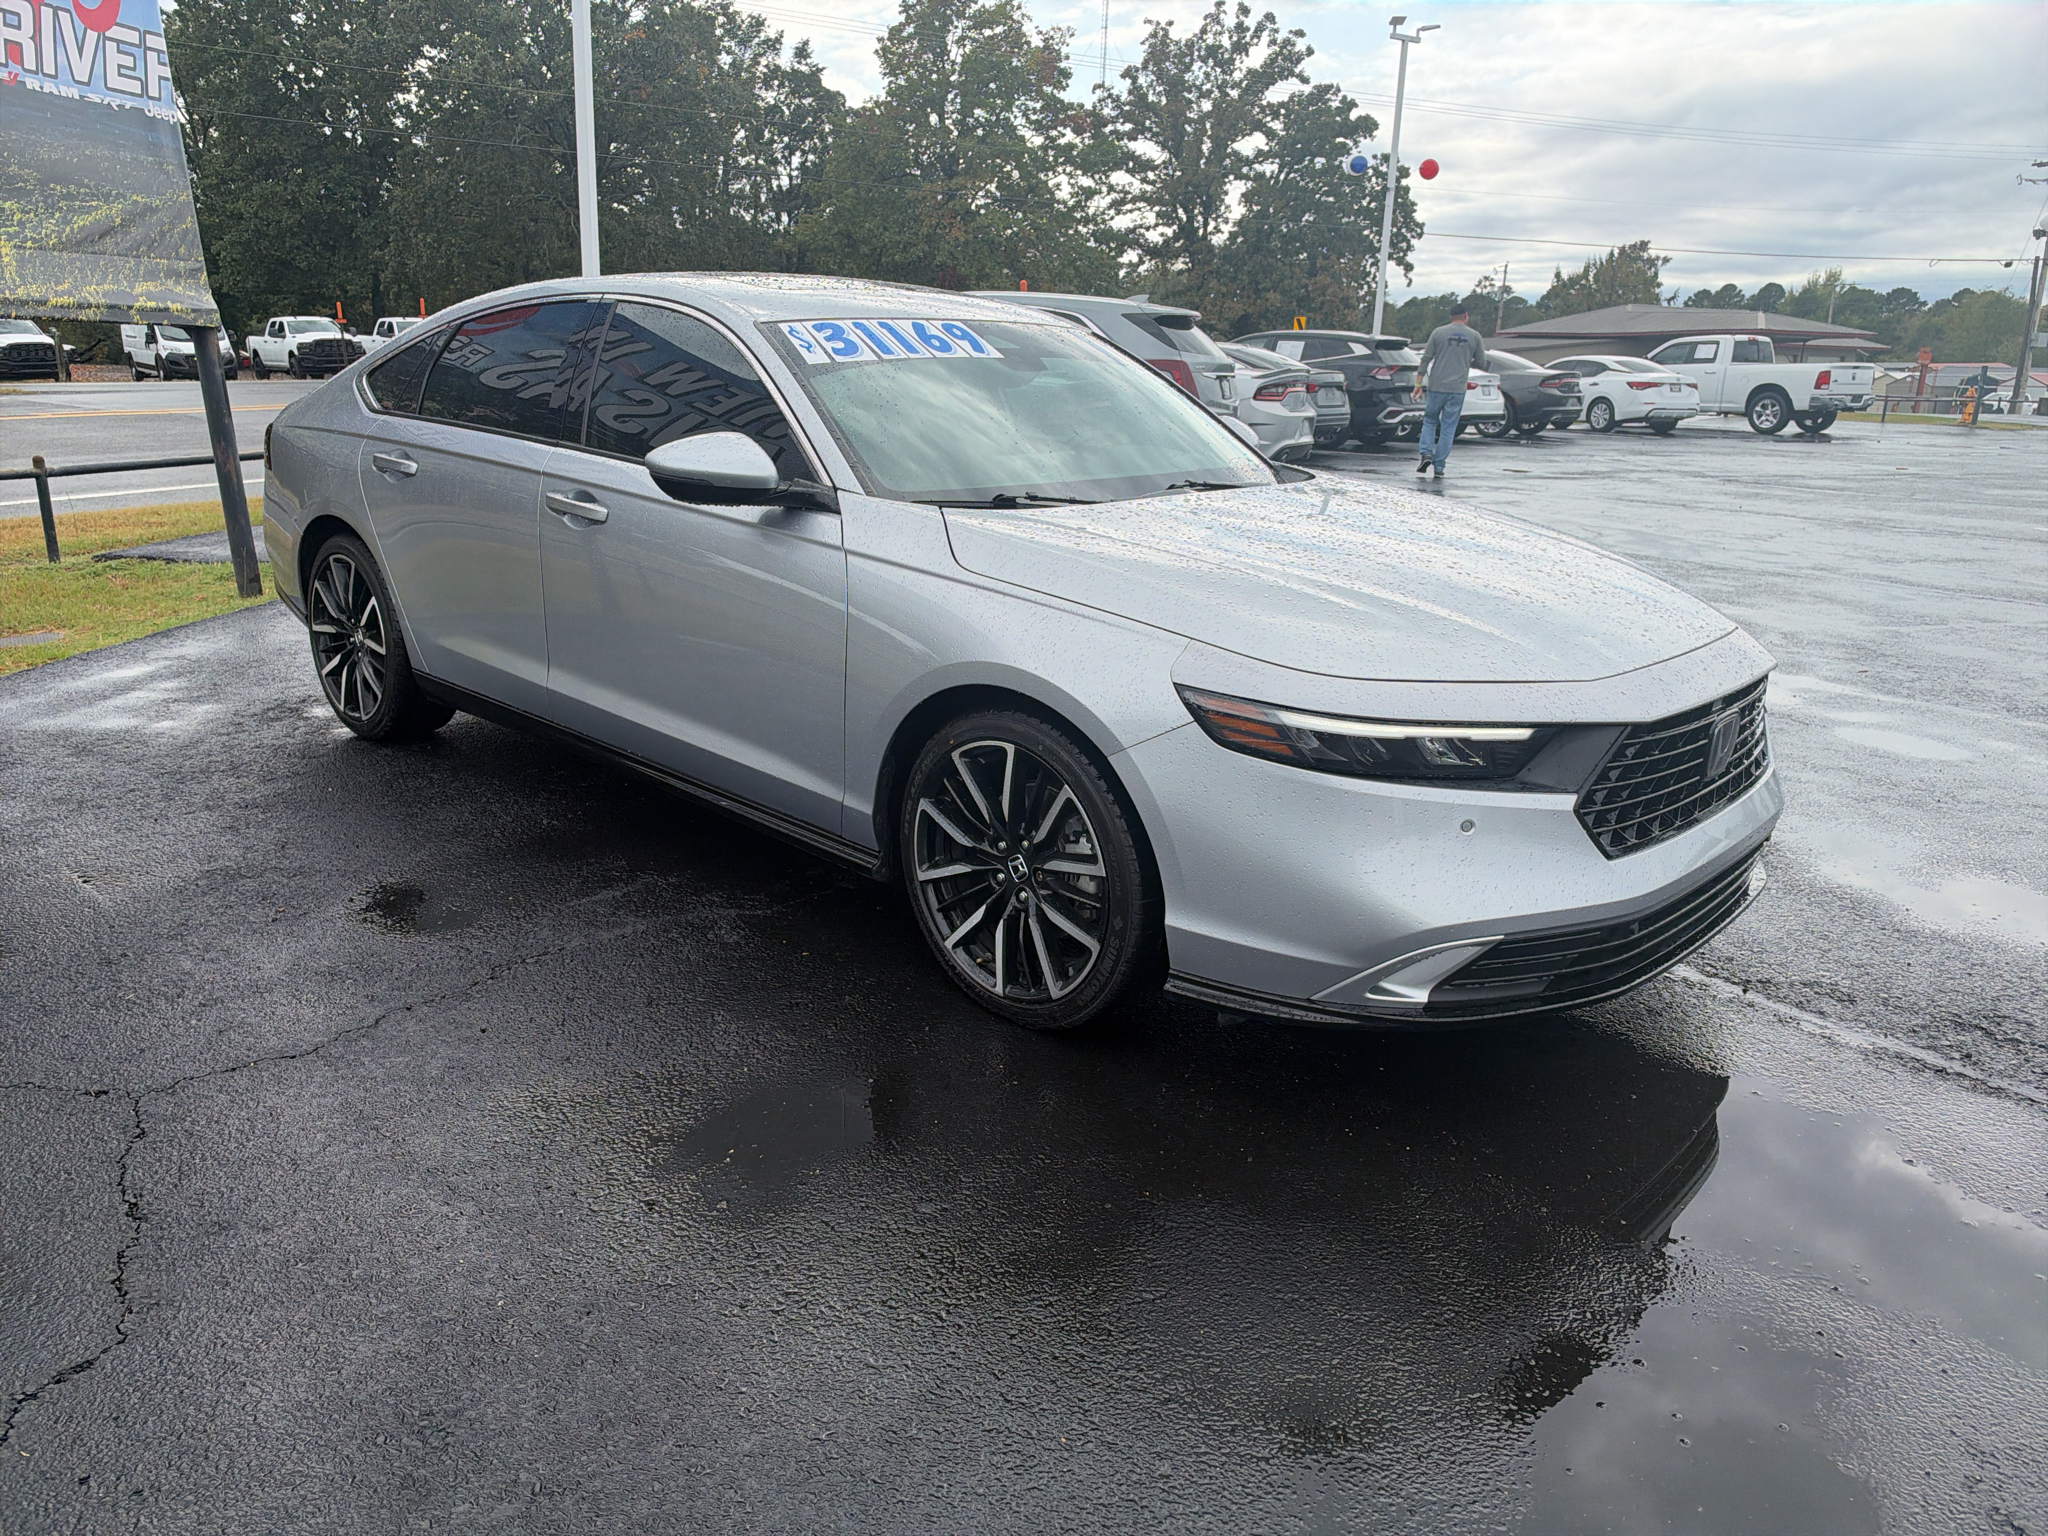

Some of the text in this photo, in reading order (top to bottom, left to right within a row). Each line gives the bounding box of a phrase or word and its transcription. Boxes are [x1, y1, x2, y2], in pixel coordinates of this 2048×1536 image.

[25, 77, 178, 125] RAM SRT Jeep
[787, 321, 991, 357] $31169
[1076, 936, 1120, 1006] SUMITOMO
